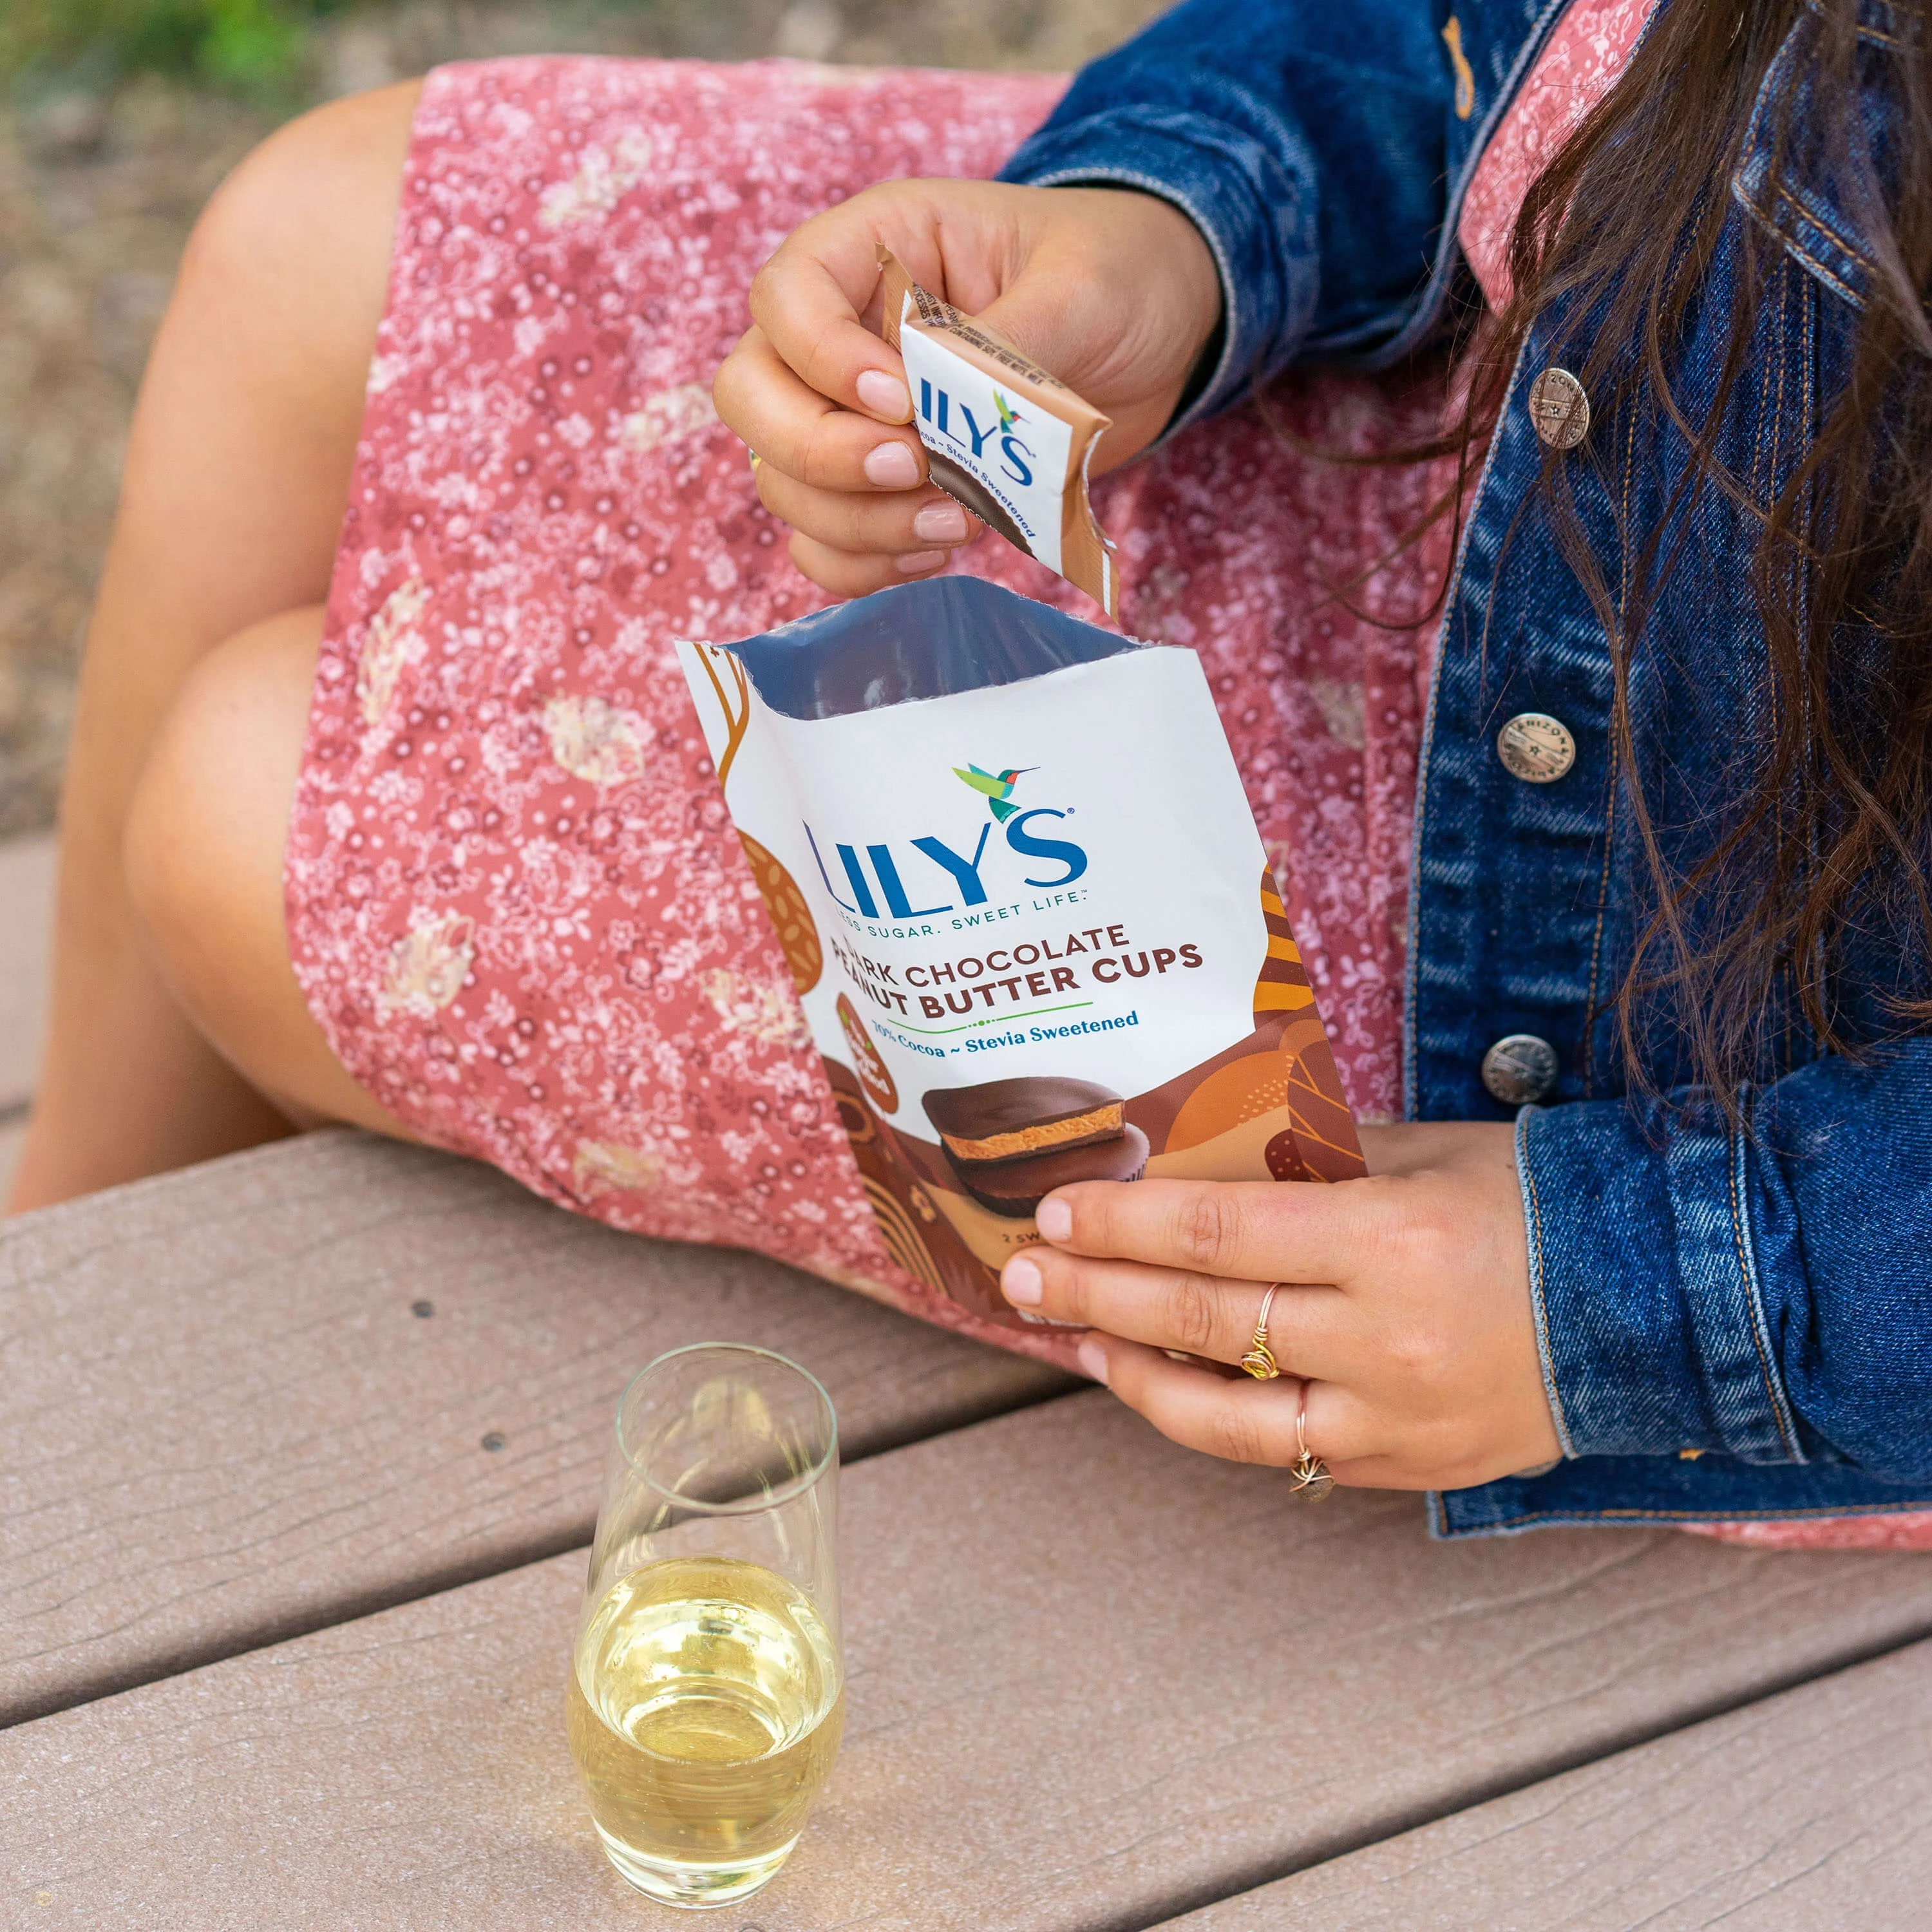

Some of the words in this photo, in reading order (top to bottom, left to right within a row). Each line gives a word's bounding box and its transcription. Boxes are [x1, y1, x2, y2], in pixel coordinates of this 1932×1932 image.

[947, 443, 978, 473] Stevia
[981, 472, 1036, 537] Sweetened
[867, 925, 941, 938] SUGAR.
[951, 904, 1021, 930] SWEET
[830, 936, 908, 1016] PEANUT
[918, 967, 1081, 1019] BUTTER
[1092, 943, 1204, 983] CUPS
[843, 934, 900, 986] DARK
[905, 923, 1130, 987] CHOCOLATE
[897, 1034, 945, 1058] Cocoa
[965, 1032, 1026, 1054] Stevia
[1030, 1010, 1139, 1043] Sweetened
